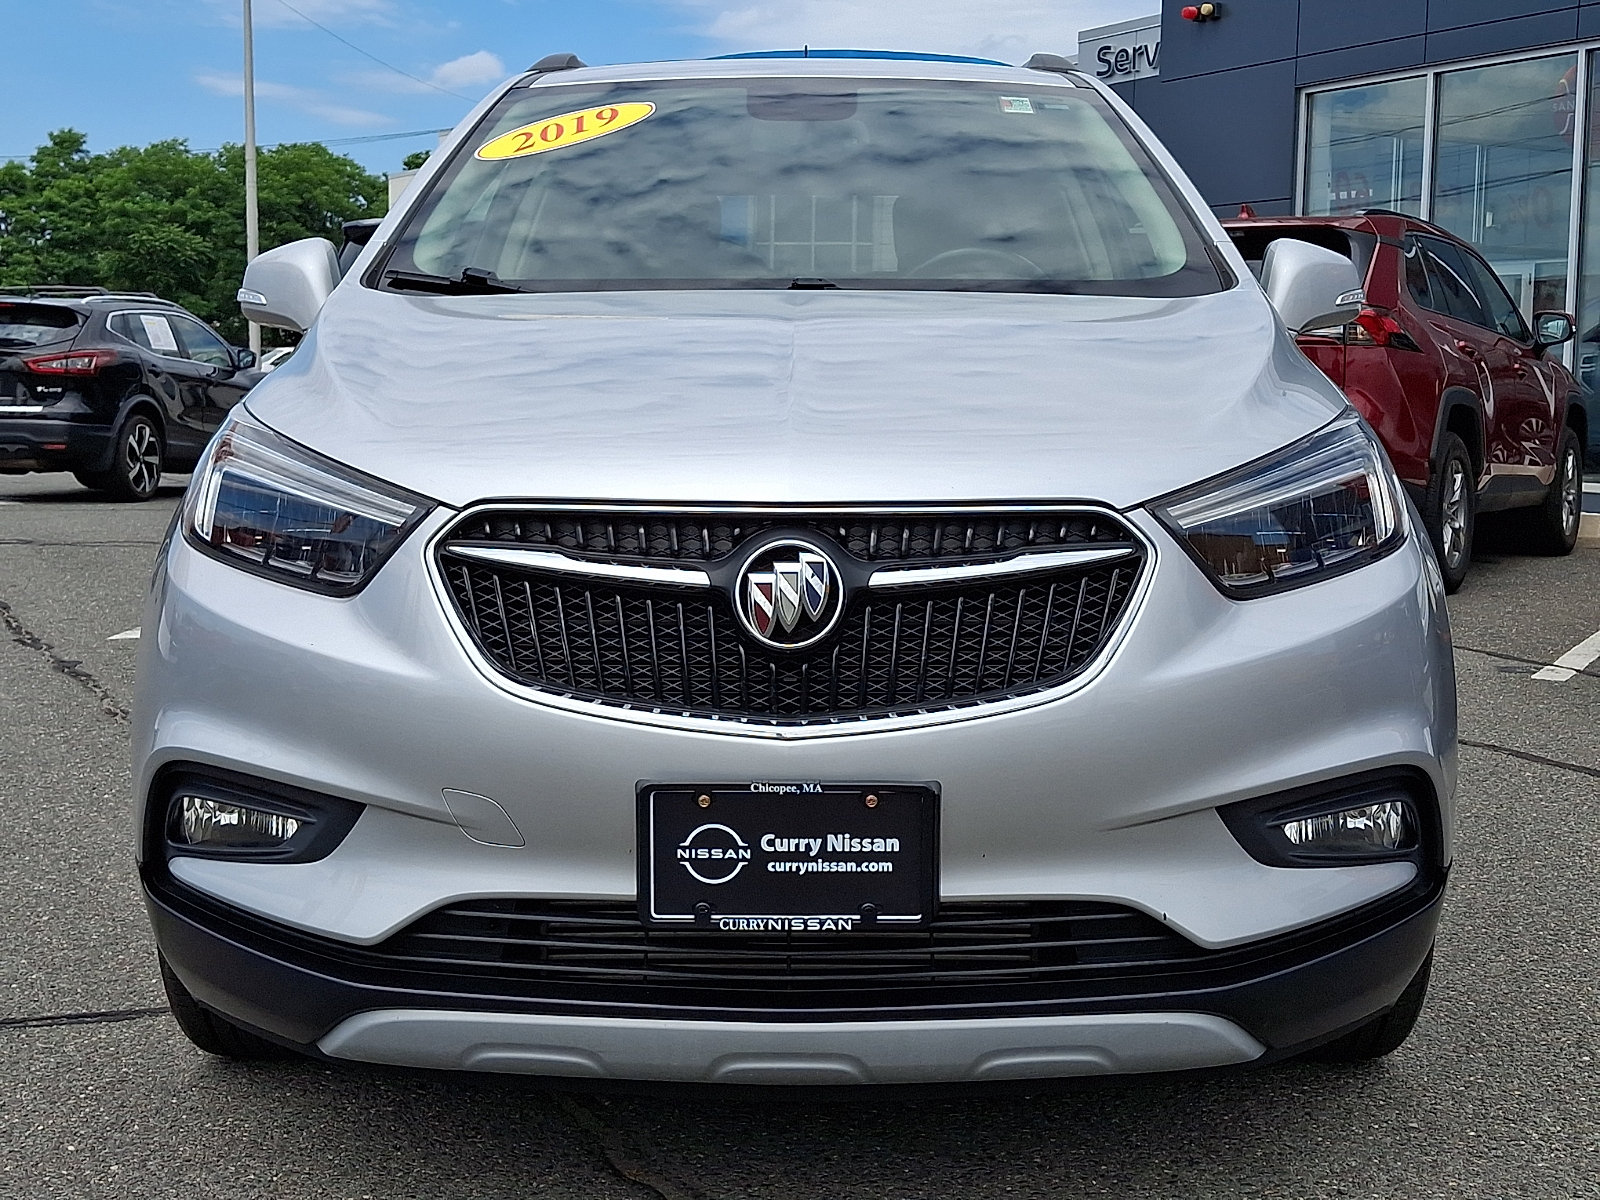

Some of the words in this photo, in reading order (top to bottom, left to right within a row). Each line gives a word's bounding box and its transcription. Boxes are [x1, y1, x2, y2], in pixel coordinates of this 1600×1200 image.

[1096, 42, 1161, 78] Serv
[511, 107, 619, 153] 2019
[750, 782, 800, 794] Chicopee,
[802, 783, 823, 793] MA
[677, 848, 751, 859] NISSAN
[760, 834, 821, 856] Curry
[827, 834, 900, 852] Nissan
[767, 859, 893, 875] currynissan.com
